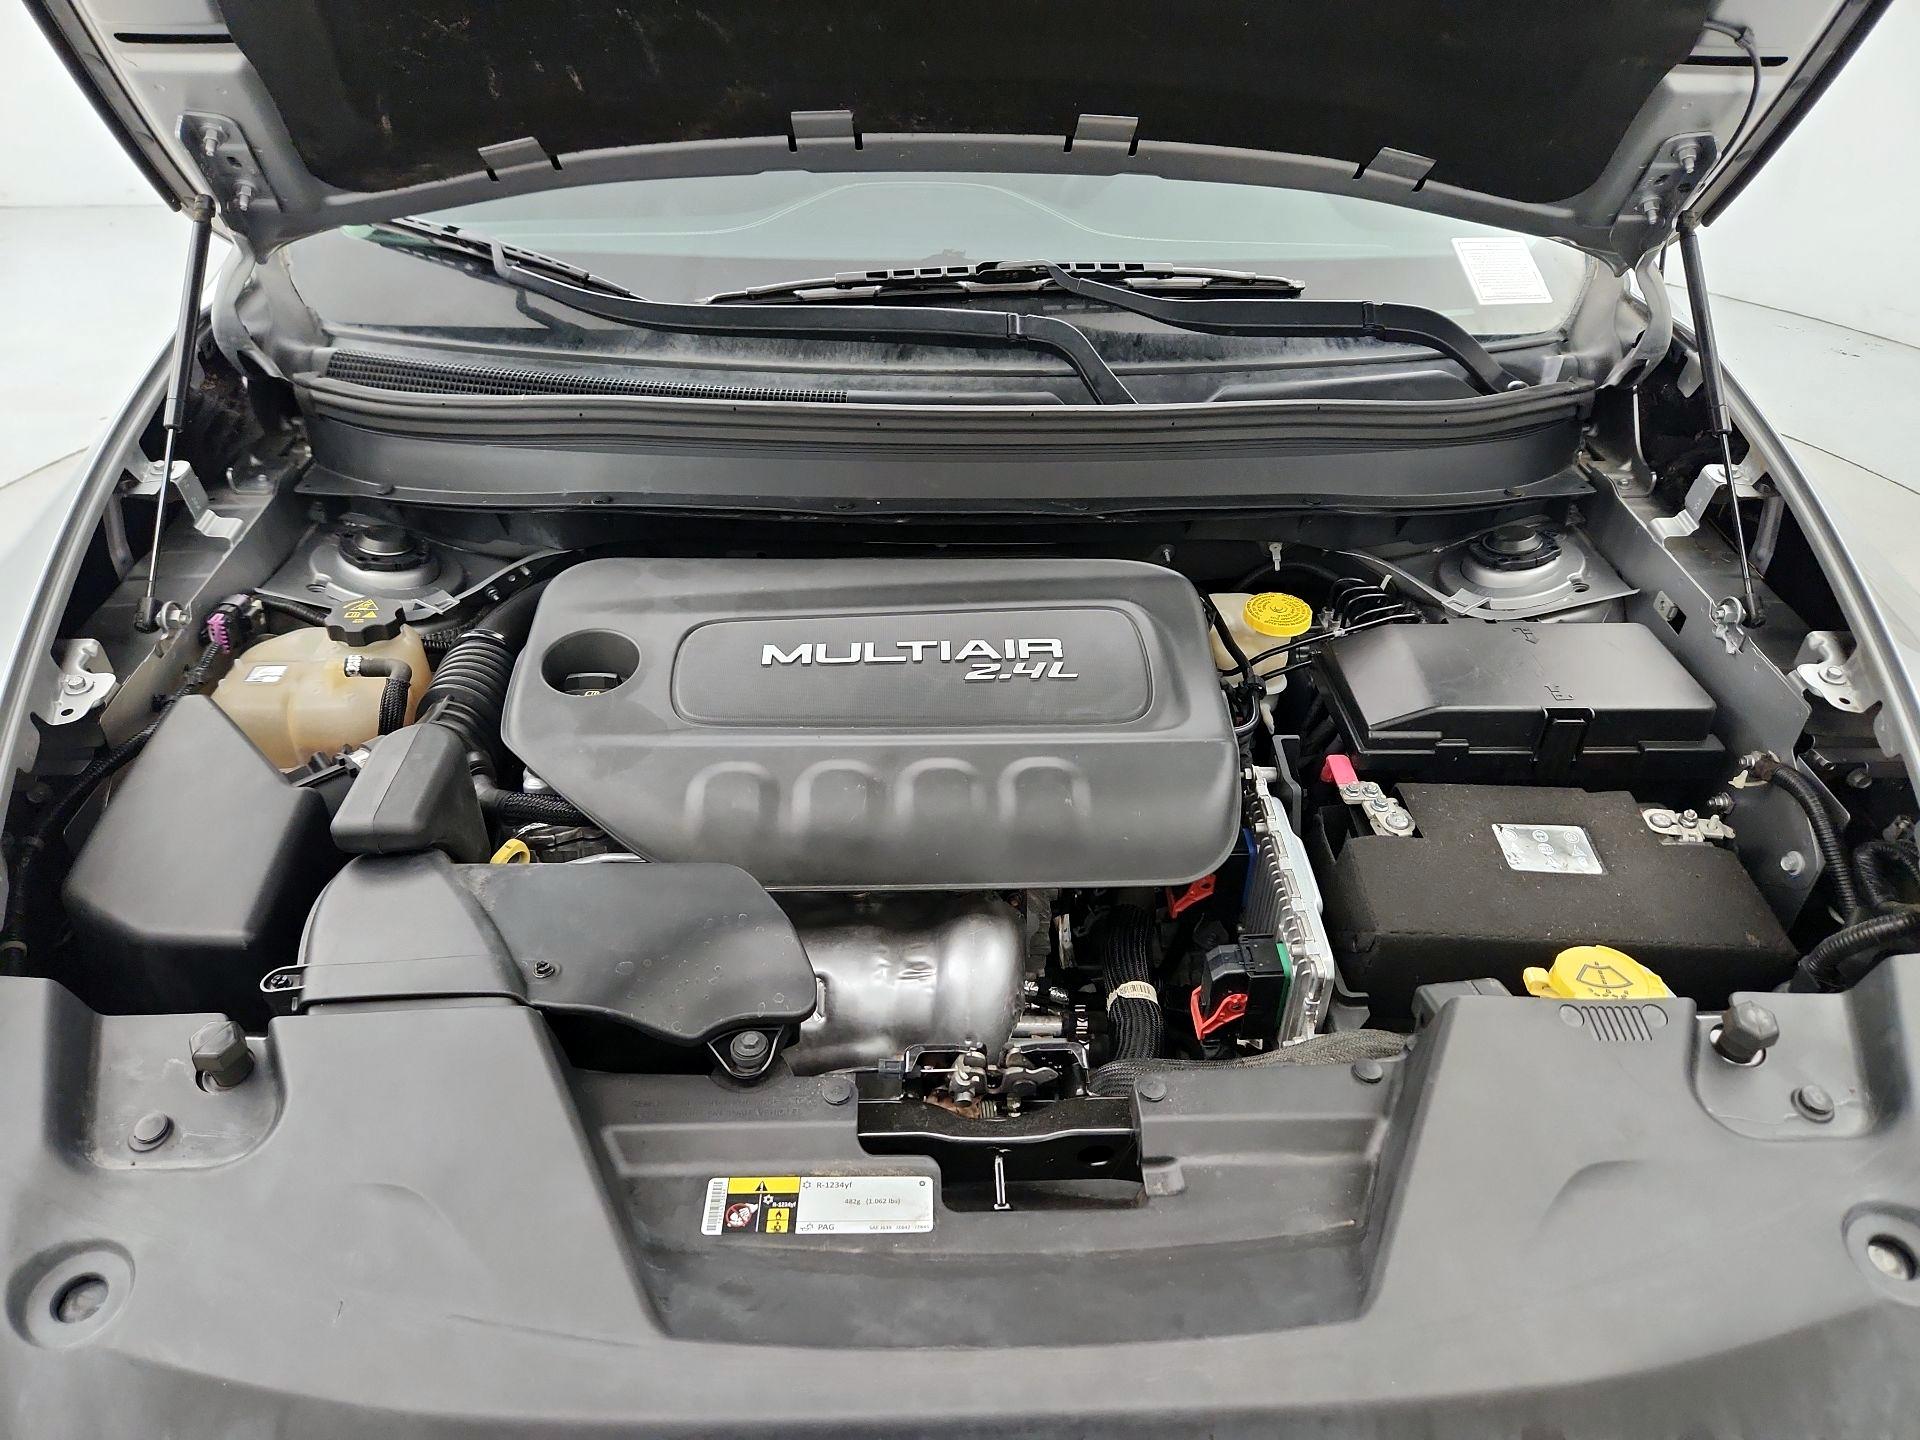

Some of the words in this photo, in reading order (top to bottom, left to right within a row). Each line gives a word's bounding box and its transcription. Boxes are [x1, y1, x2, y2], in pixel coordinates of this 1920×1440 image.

[760, 637, 1064, 667] MULTIAIR
[963, 661, 1079, 681] 2.4L
[816, 1181, 852, 1190] R-1234yf
[817, 1223, 835, 1231] PAG
